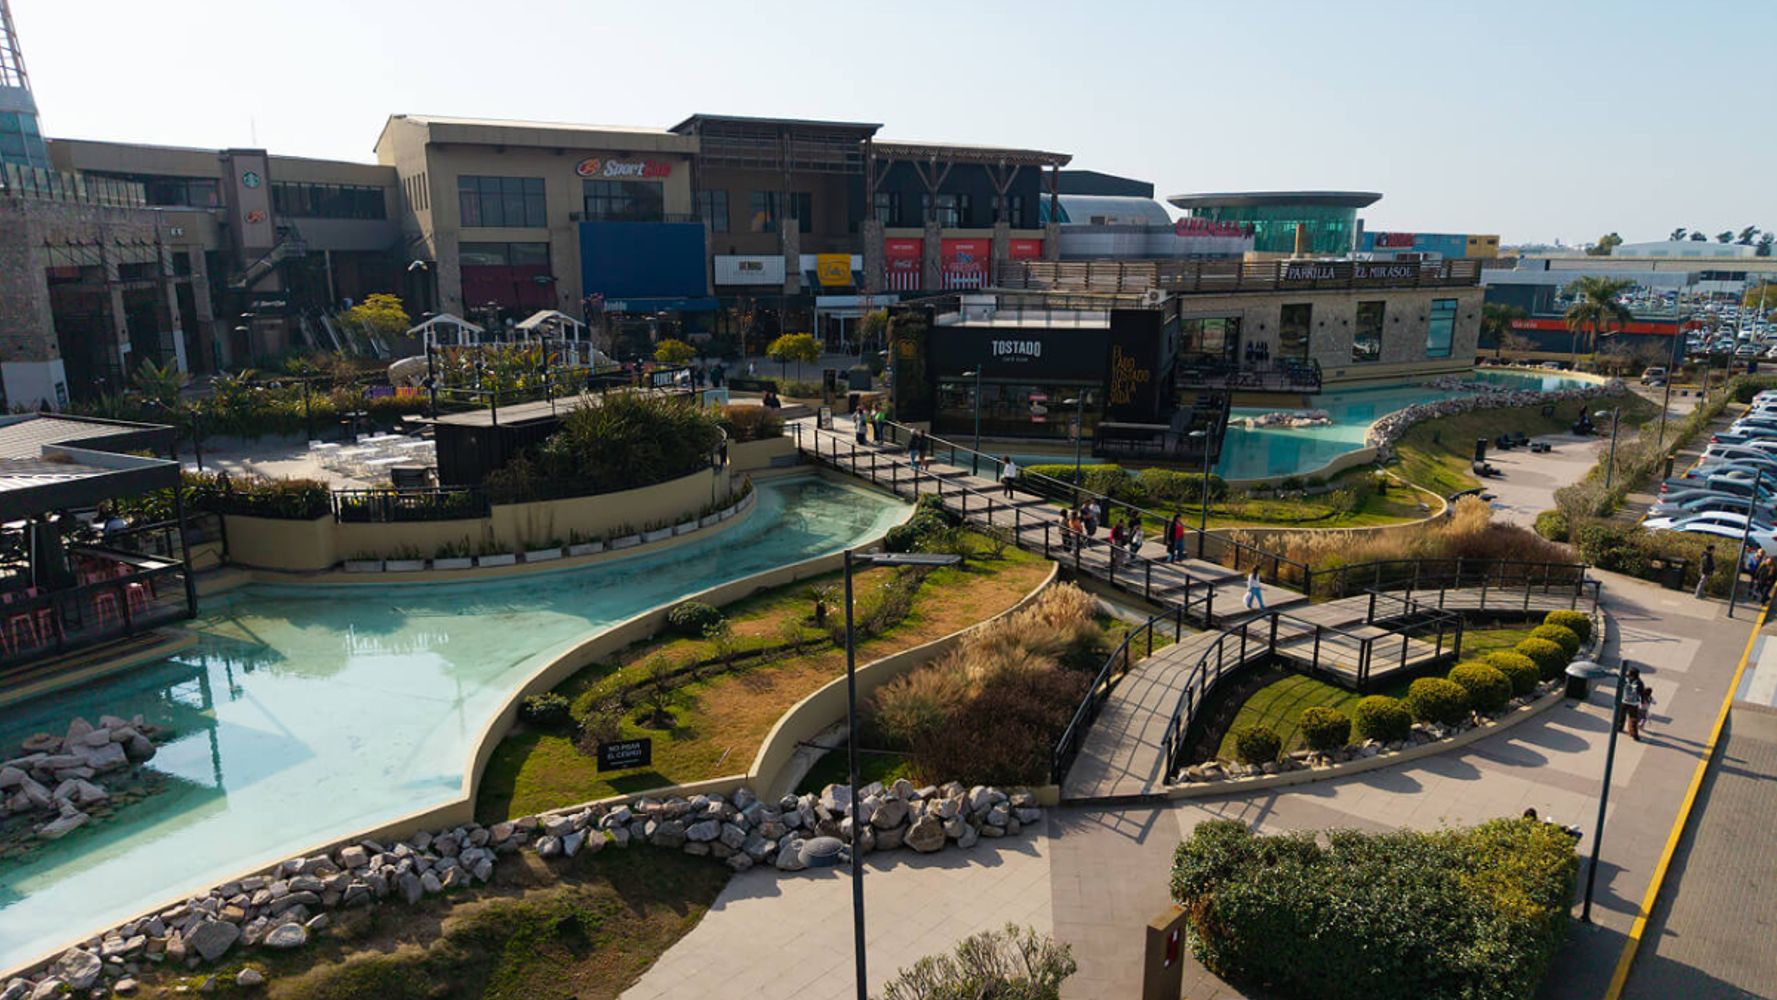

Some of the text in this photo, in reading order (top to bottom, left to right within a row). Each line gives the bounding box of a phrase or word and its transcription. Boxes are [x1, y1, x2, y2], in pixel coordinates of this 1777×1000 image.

[1287, 265, 1413, 280] PARRILLA EL MIRASOL
[991, 340, 1041, 357] TOSTADO
